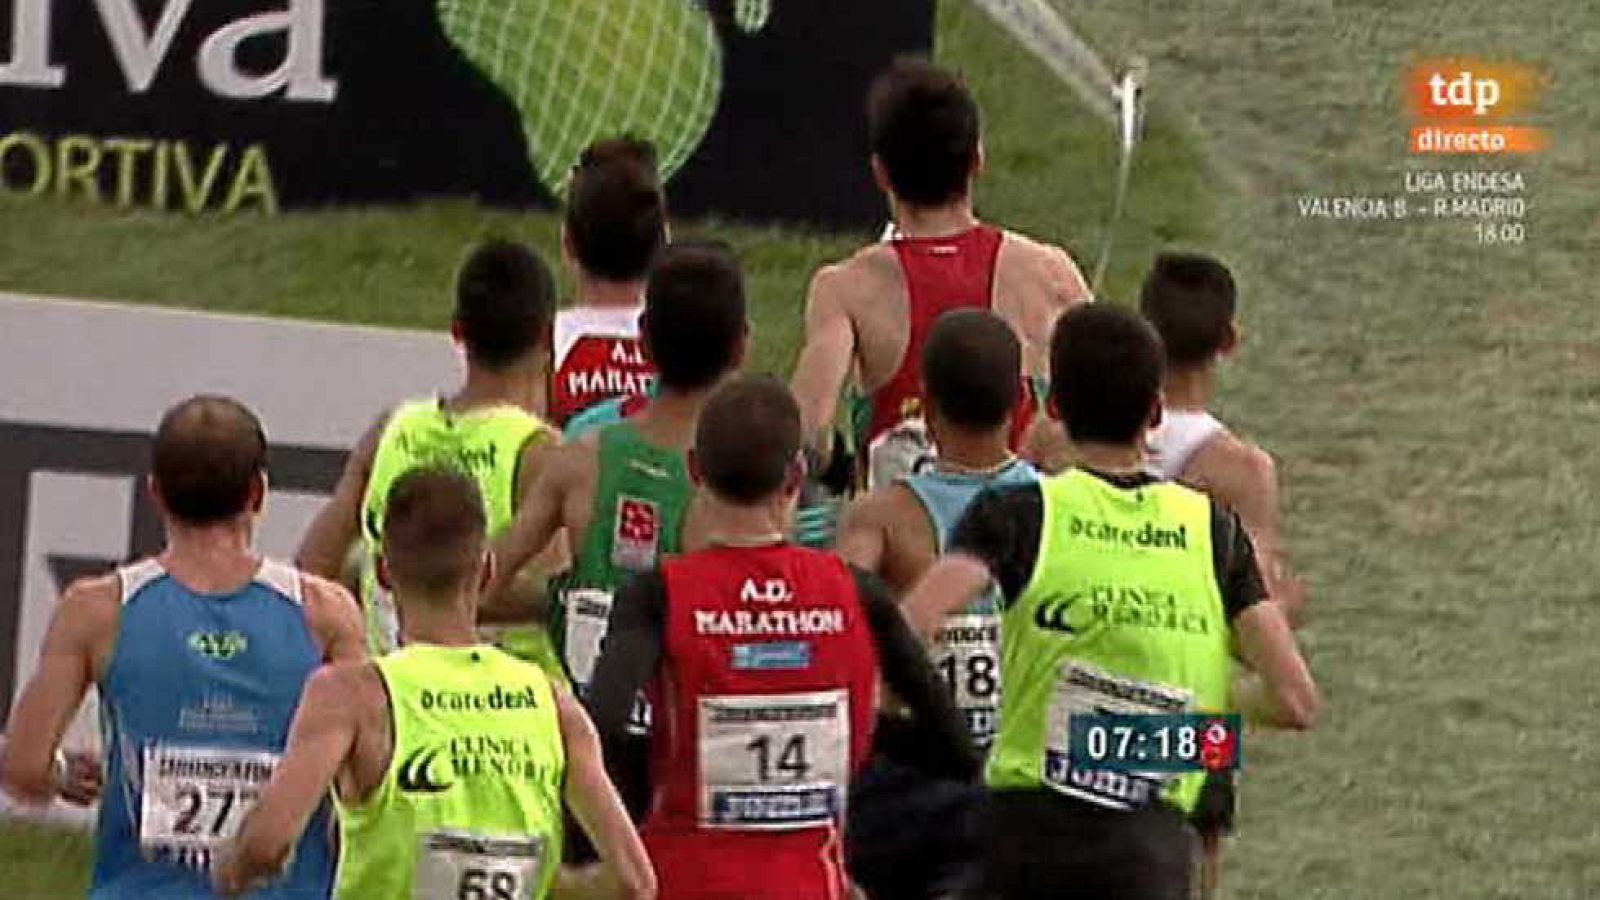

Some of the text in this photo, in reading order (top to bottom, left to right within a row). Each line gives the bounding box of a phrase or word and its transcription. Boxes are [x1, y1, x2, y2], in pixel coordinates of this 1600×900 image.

[741, 578, 793, 601] A.D.
[695, 609, 843, 634] MARATHON
[939, 655, 996, 702] 18
[746, 734, 812, 780] 14
[173, 785, 236, 834] 27
